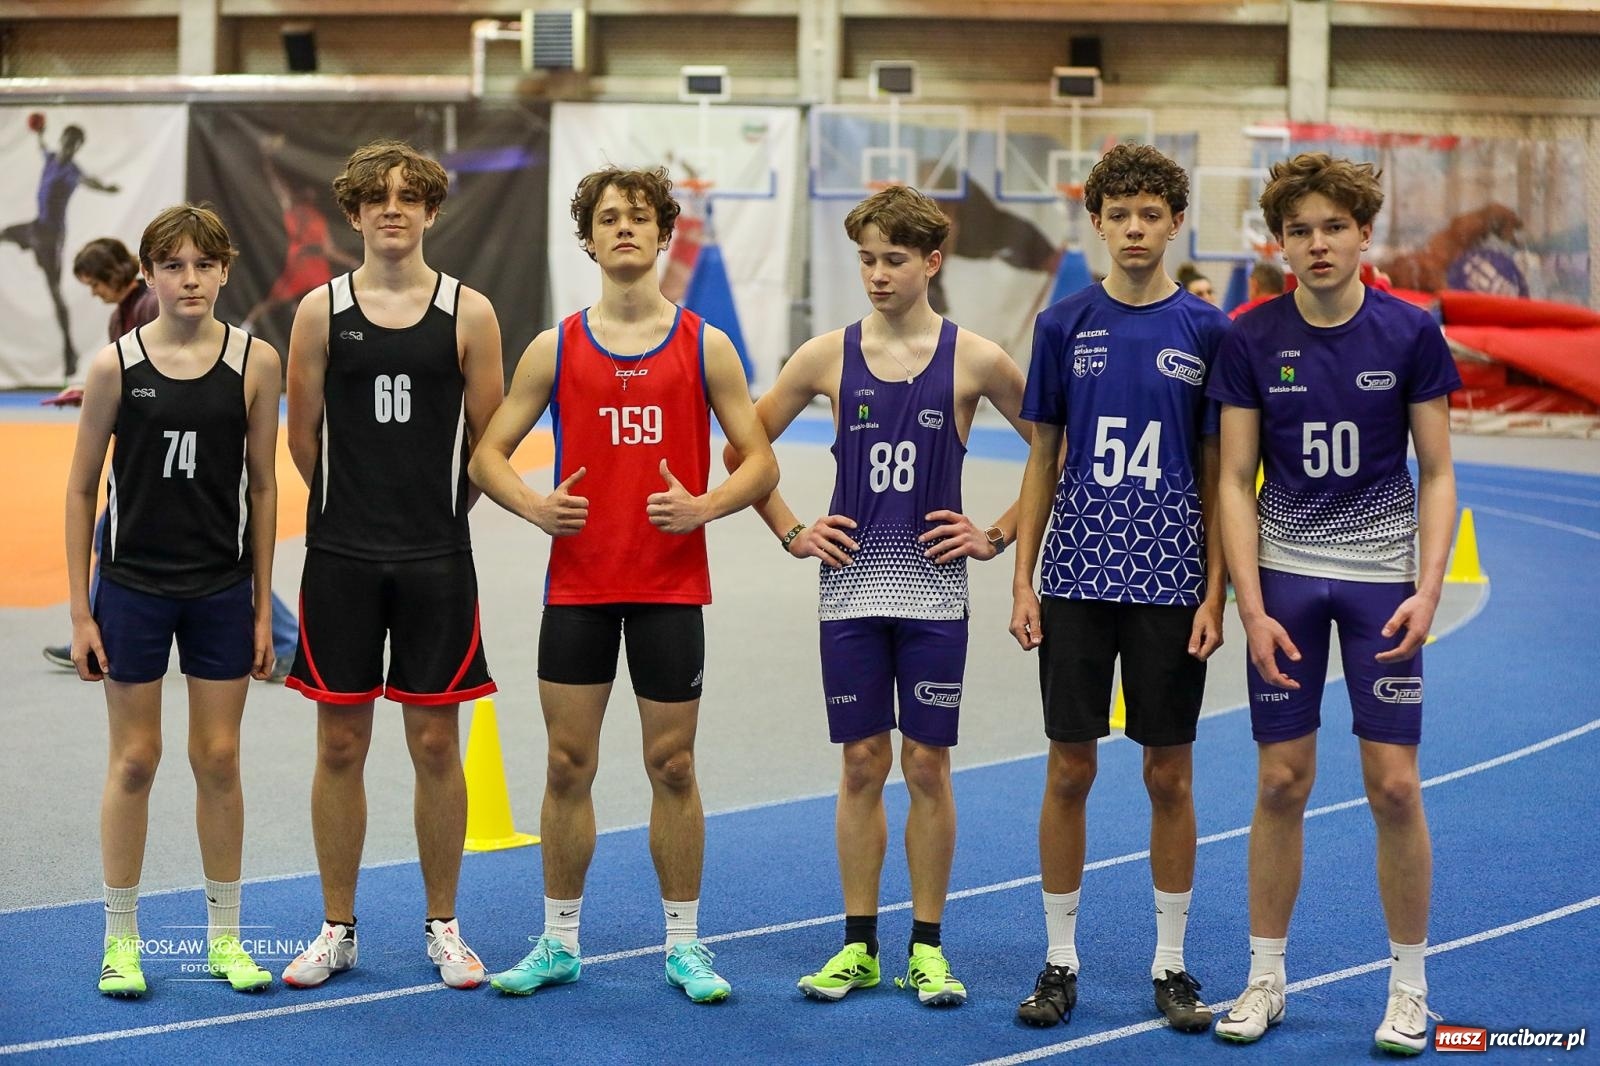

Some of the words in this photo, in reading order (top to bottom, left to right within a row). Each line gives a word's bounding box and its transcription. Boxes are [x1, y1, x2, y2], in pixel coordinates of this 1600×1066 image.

[339, 330, 364, 341] esa
[131, 388, 157, 398] esa
[374, 373, 412, 424] 66
[598, 405, 663, 446] 759
[1302, 421, 1360, 478] 50
[162, 430, 197, 479] 74
[869, 440, 917, 493] 88
[1092, 415, 1162, 491] 54
[914, 681, 961, 708] Sprint
